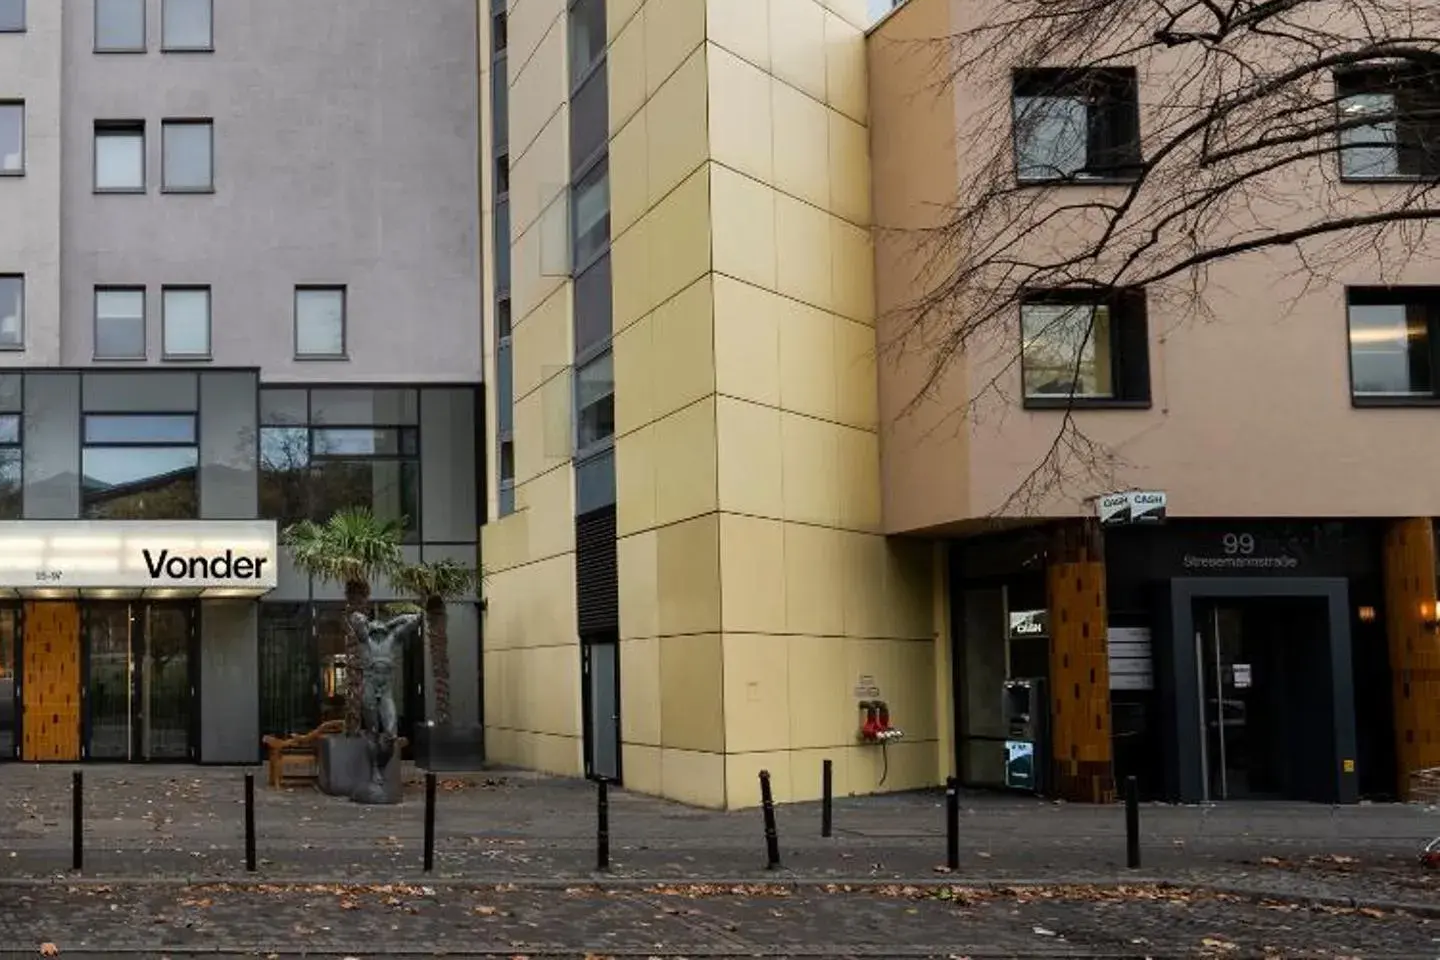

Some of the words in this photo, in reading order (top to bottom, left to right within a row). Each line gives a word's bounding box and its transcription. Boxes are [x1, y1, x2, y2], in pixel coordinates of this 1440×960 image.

[1134, 495, 1162, 504] CASH
[1222, 532, 1255, 554] 99
[142, 548, 268, 579] Vonder
